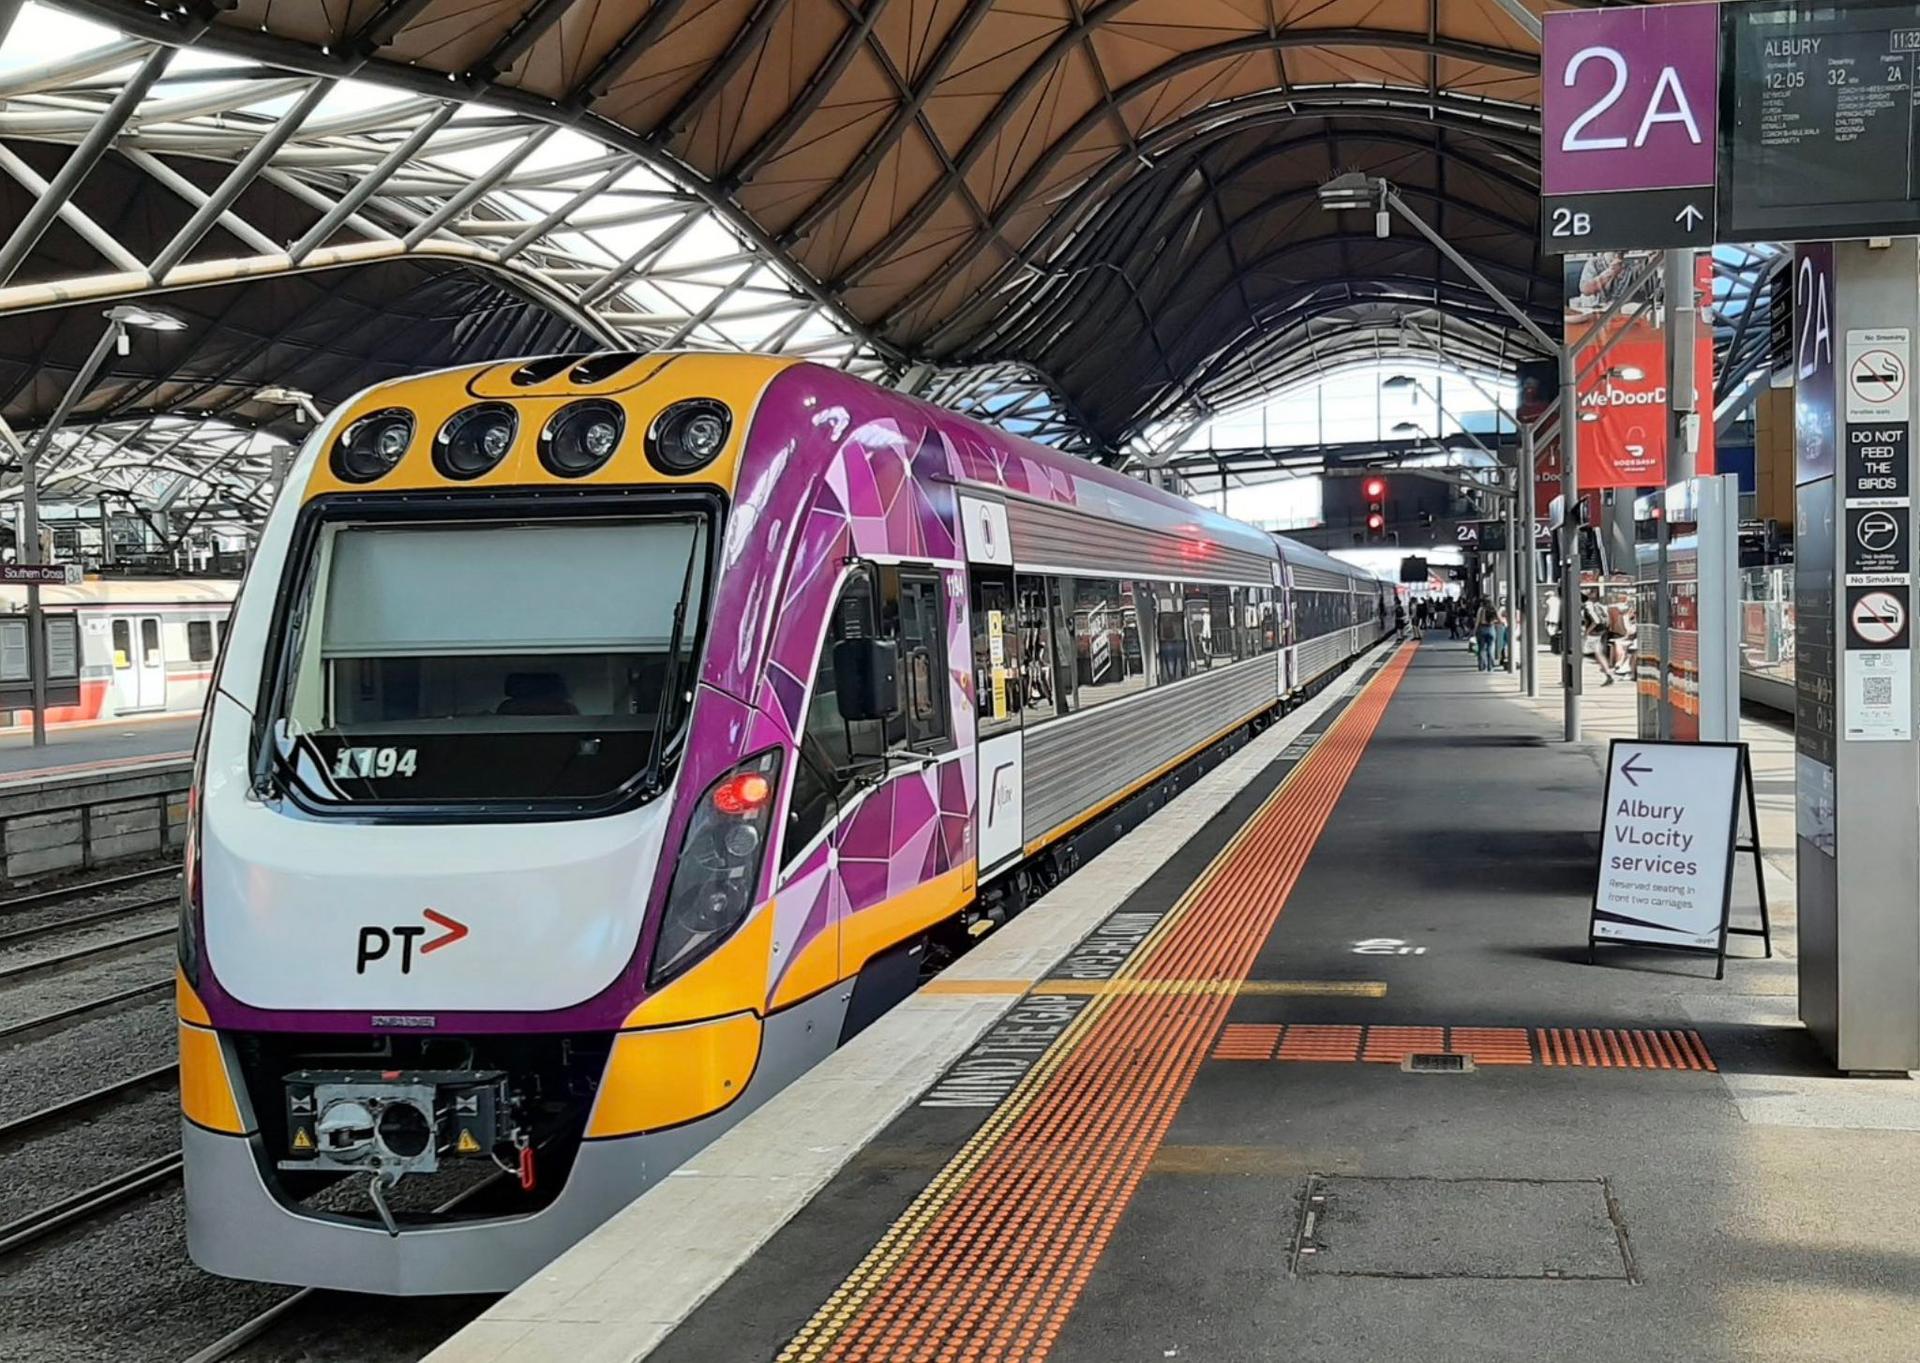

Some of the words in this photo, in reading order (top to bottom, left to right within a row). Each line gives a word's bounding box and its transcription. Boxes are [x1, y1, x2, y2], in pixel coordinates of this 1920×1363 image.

[1765, 38, 1821, 57] ALBURY
[1765, 72, 1805, 89] 12:05
[1828, 69, 1846, 85] 32
[1887, 66, 1901, 82] 2A
[1562, 46, 1701, 151] 2A
[1552, 208, 1591, 237] 2B
[1798, 256, 1831, 381] 2A
[1852, 431, 1872, 443] DO
[1875, 430, 1904, 443] NOT
[1861, 446, 1894, 459] FEED
[1864, 461, 1892, 474] THE
[1858, 477, 1897, 490] BIRDS
[1457, 526, 1477, 541] 2A
[1533, 523, 1551, 538] 2A
[4, 566, 40, 579] Southern
[41, 567, 65, 579] Cross
[1851, 576, 1863, 584] No
[1866, 575, 1905, 585] Smoking
[333, 748, 418, 779] 1194
[1617, 799, 1685, 825] Albury
[1614, 825, 1693, 853] VLocity
[1610, 854, 1698, 876] services
[1609, 879, 1651, 892] Reserved
[1652, 883, 1686, 897] seating
[1686, 885, 1696, 896] in
[1608, 893, 1631, 904] front
[1632, 895, 1649, 905] two
[1006, 995, 1087, 1024] GAP
[969, 1025, 1063, 1056] THE
[919, 1057, 1031, 1107] MIND
